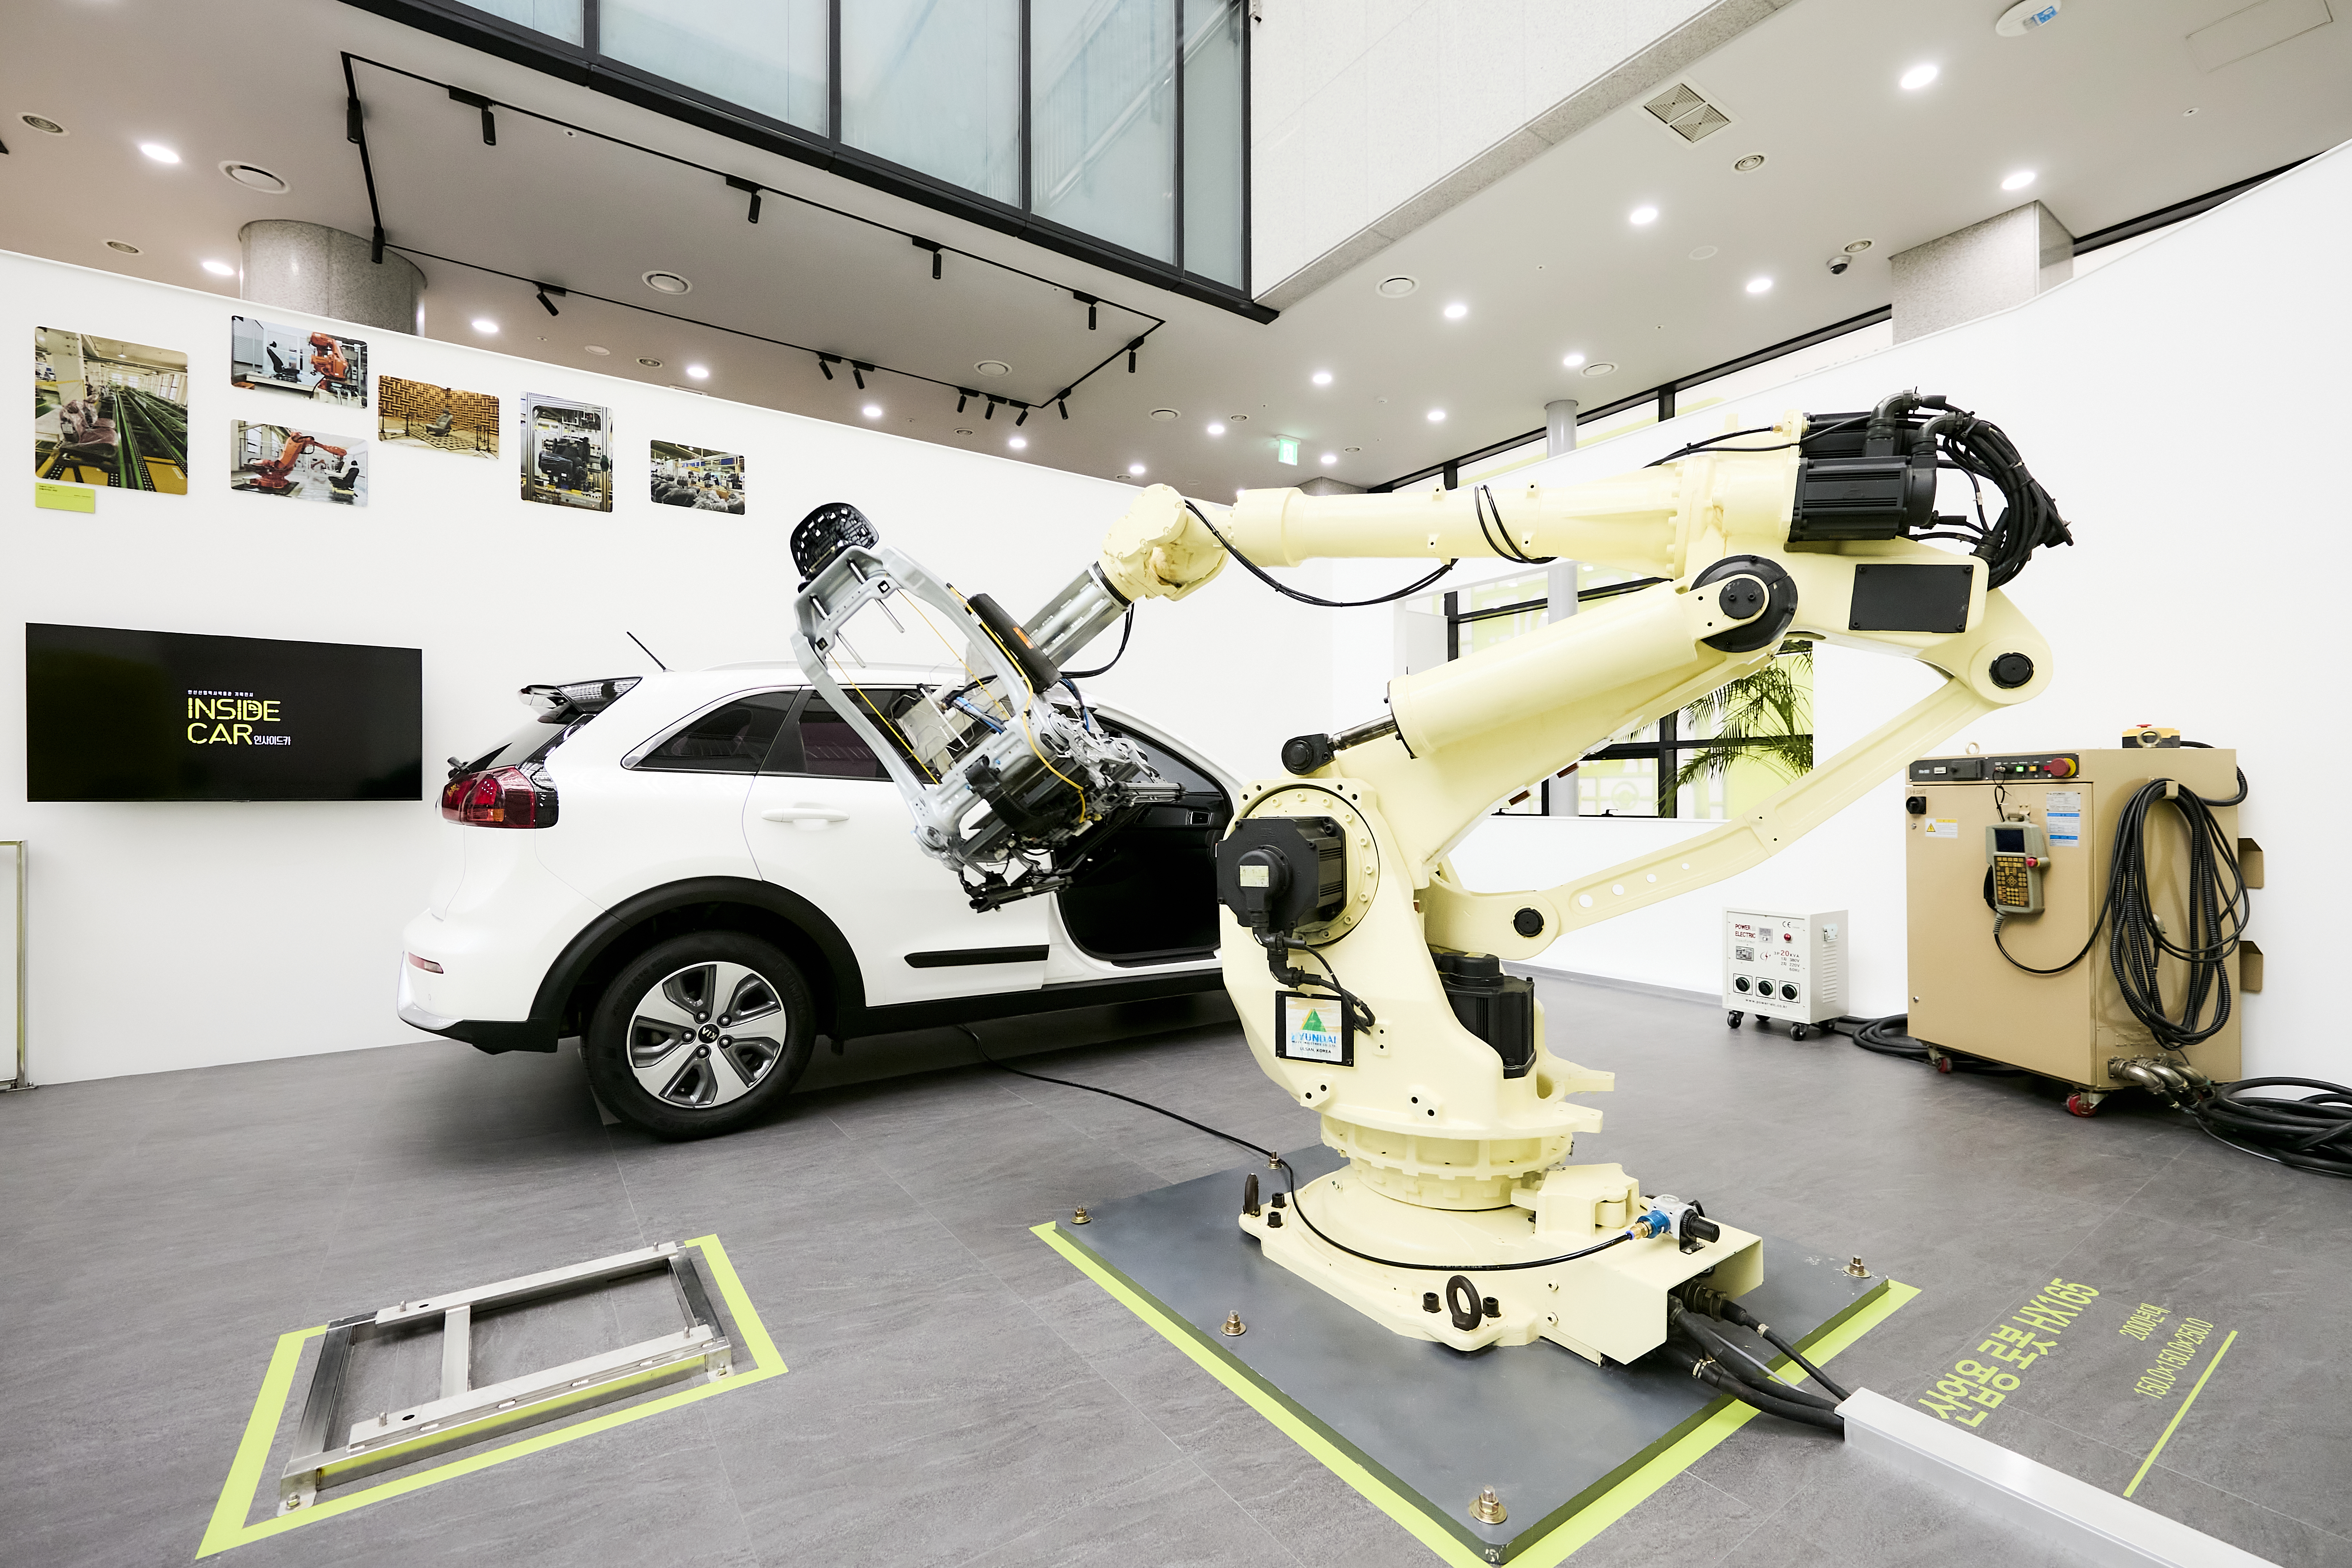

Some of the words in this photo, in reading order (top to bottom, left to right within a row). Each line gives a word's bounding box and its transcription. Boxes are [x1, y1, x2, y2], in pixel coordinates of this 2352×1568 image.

[188, 697, 281, 721] INSIDE
[188, 723, 252, 745] CAR
[254, 735, 291, 745] 인사이드카
[702, 1027, 718, 1040] KIA
[2012, 1278, 2099, 1334] HX165
[2119, 1303, 2171, 1341] 2000년대
[1977, 1324, 2058, 1370] 로봇
[2134, 1318, 2213, 1399] 150.0x150.0x250.0
[1918, 1359, 2020, 1427] 산업용
